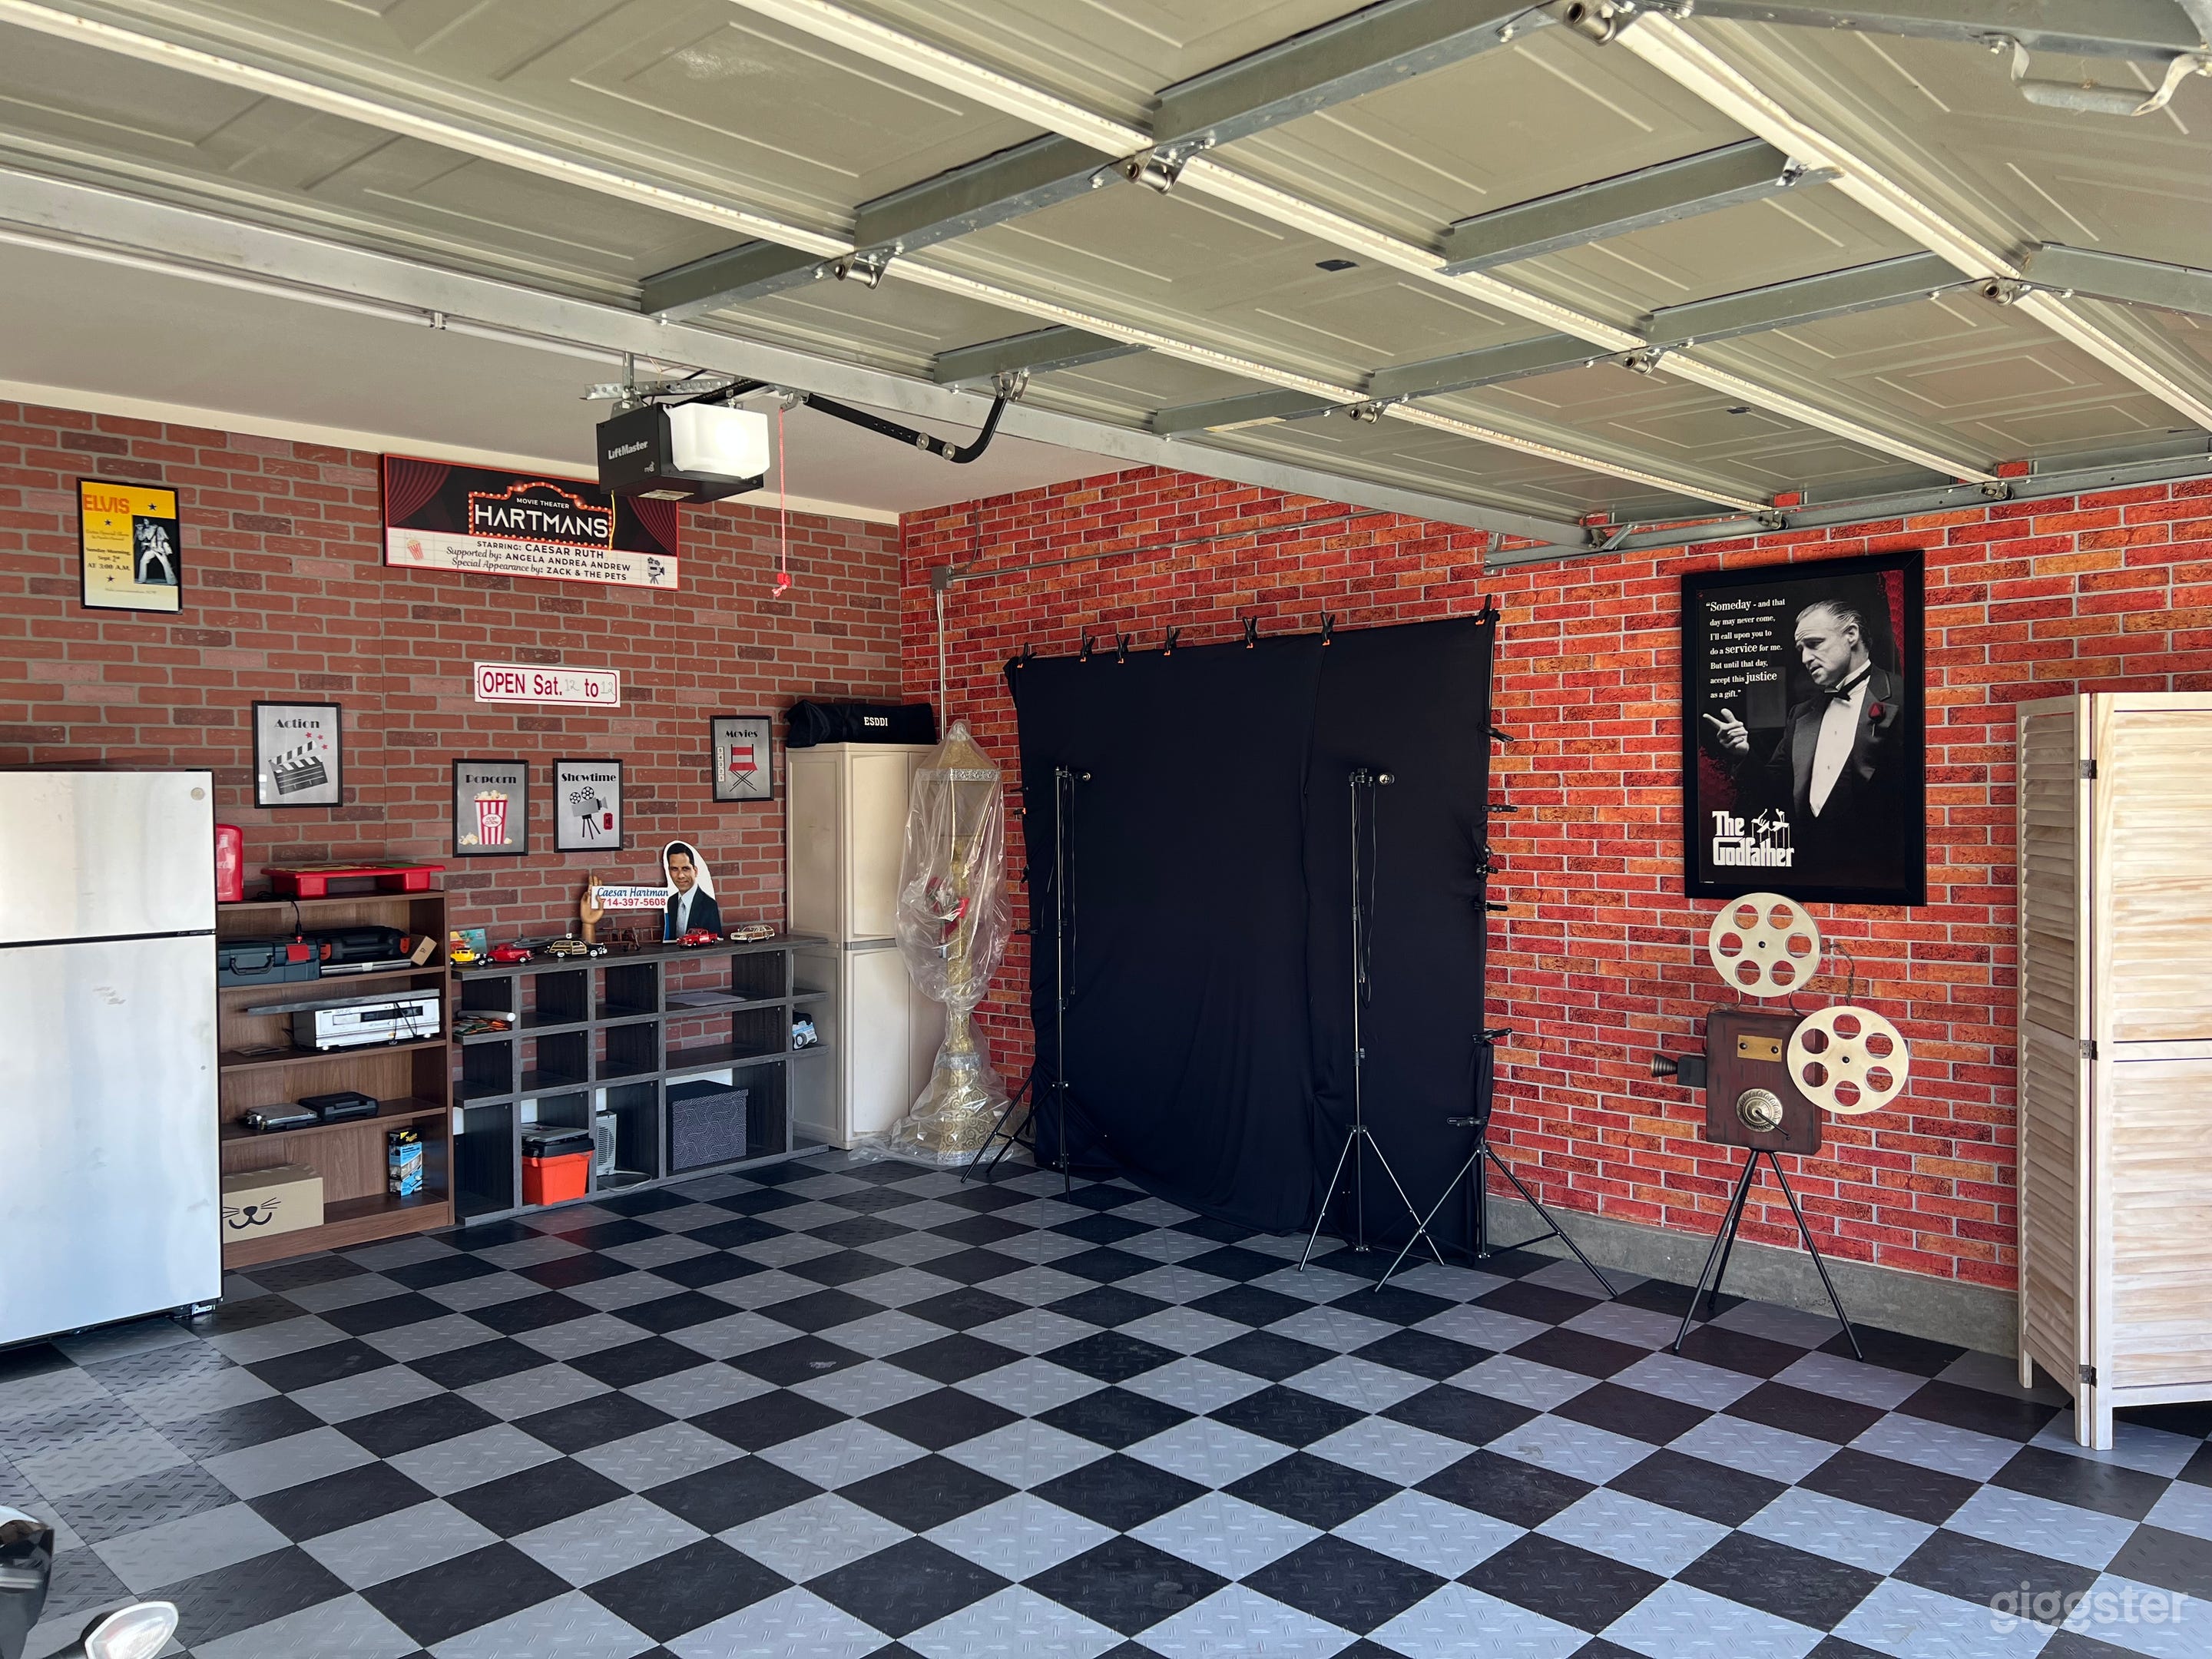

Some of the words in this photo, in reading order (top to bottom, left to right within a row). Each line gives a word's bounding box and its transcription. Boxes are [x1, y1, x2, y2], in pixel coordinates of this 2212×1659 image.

[608, 441, 648, 460] LiftMaster
[83, 494, 131, 514] ELVIS
[516, 497, 538, 505] MOVIE
[540, 500, 570, 509] THEATER
[475, 504, 608, 538] HARTMANS
[476, 541, 522, 551] STARRING:
[525, 544, 571, 556] CAESAR
[575, 549, 604, 559] RUTH
[446, 546, 487, 560] Supported
[488, 549, 502, 562] by:
[505, 552, 545, 564] ANGELA
[548, 557, 588, 568] ANDREA
[590, 561, 631, 571] ANDREW
[452, 558, 481, 570] Special
[482, 560, 529, 572] Appearance
[531, 562, 544, 575] by:
[546, 566, 571, 576] ZACK
[584, 570, 601, 578] THE
[604, 572, 627, 581] PETS
[1757, 599, 1770, 608] and
[1709, 619, 1721, 628] day
[1720, 631, 1733, 640] call
[1734, 632, 1750, 641] upon
[1725, 643, 1758, 654] service
[1710, 676, 1730, 685] accept
[1744, 671, 1778, 684] justice
[482, 671, 525, 694] OPEN
[534, 674, 562, 696] Sat.
[584, 678, 598, 697] to
[274, 719, 320, 728] Action
[863, 717, 889, 727] ESDDI
[725, 730, 758, 738] Movies
[465, 774, 517, 784] Popcorn
[561, 773, 617, 782] Showtime
[1712, 810, 1745, 836] The
[1712, 836, 1795, 867] Godfather
[597, 887, 627, 897] Caesar
[629, 886, 669, 897] Hartman
[602, 898, 666, 907] 714-397-5608
